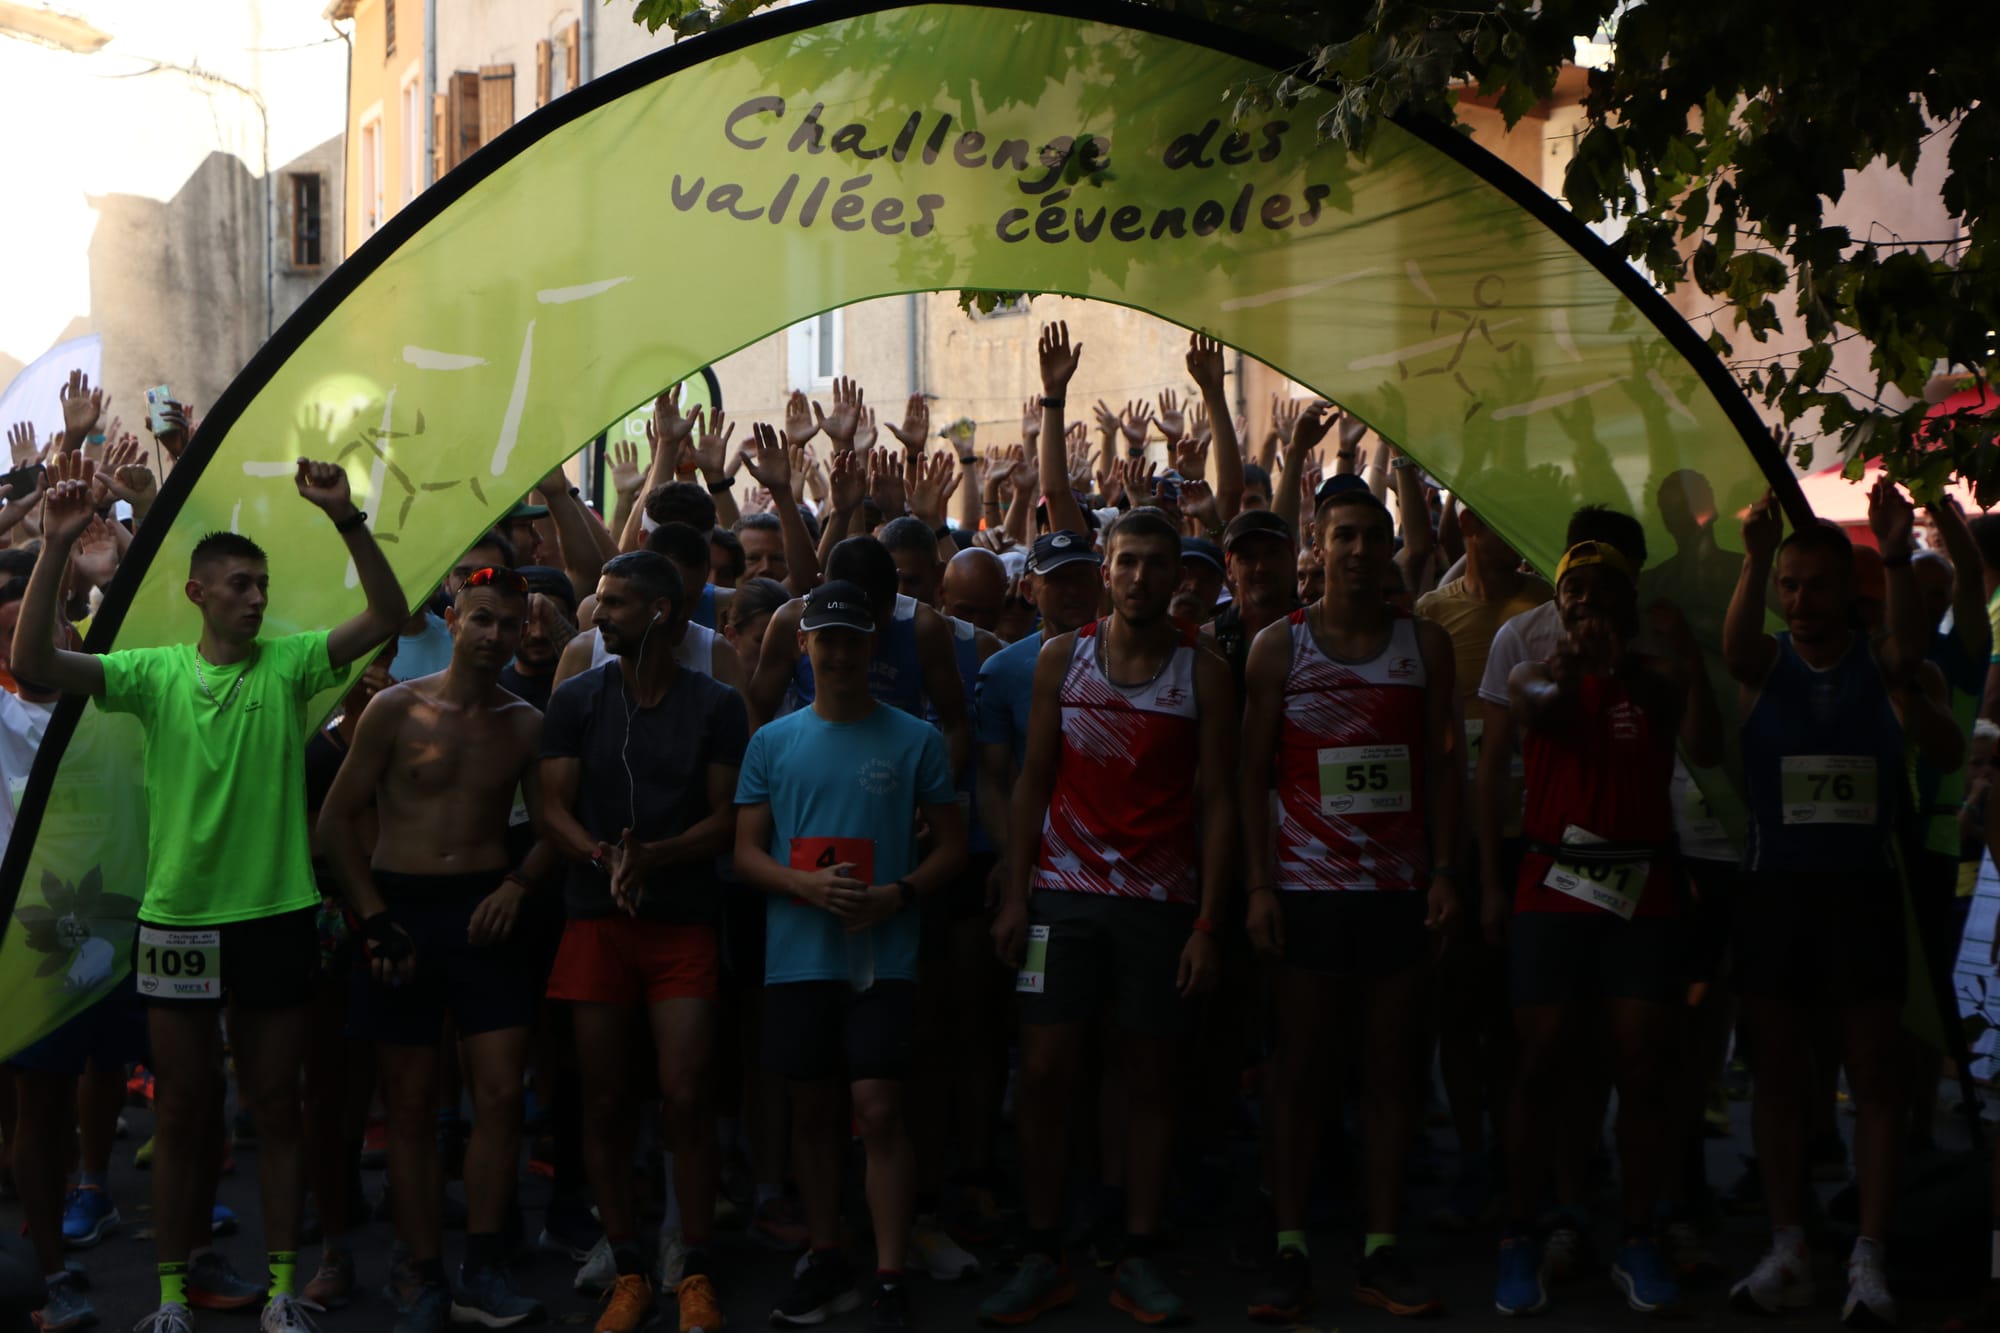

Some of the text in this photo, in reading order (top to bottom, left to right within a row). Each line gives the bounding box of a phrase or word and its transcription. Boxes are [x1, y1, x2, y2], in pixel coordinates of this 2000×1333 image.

[724, 95, 1291, 193] Challenge des
[670, 174, 1331, 244] vallées cévenoles
[1346, 764, 1388, 792] 55
[1807, 774, 1855, 801] 76
[146, 947, 206, 977] 109
